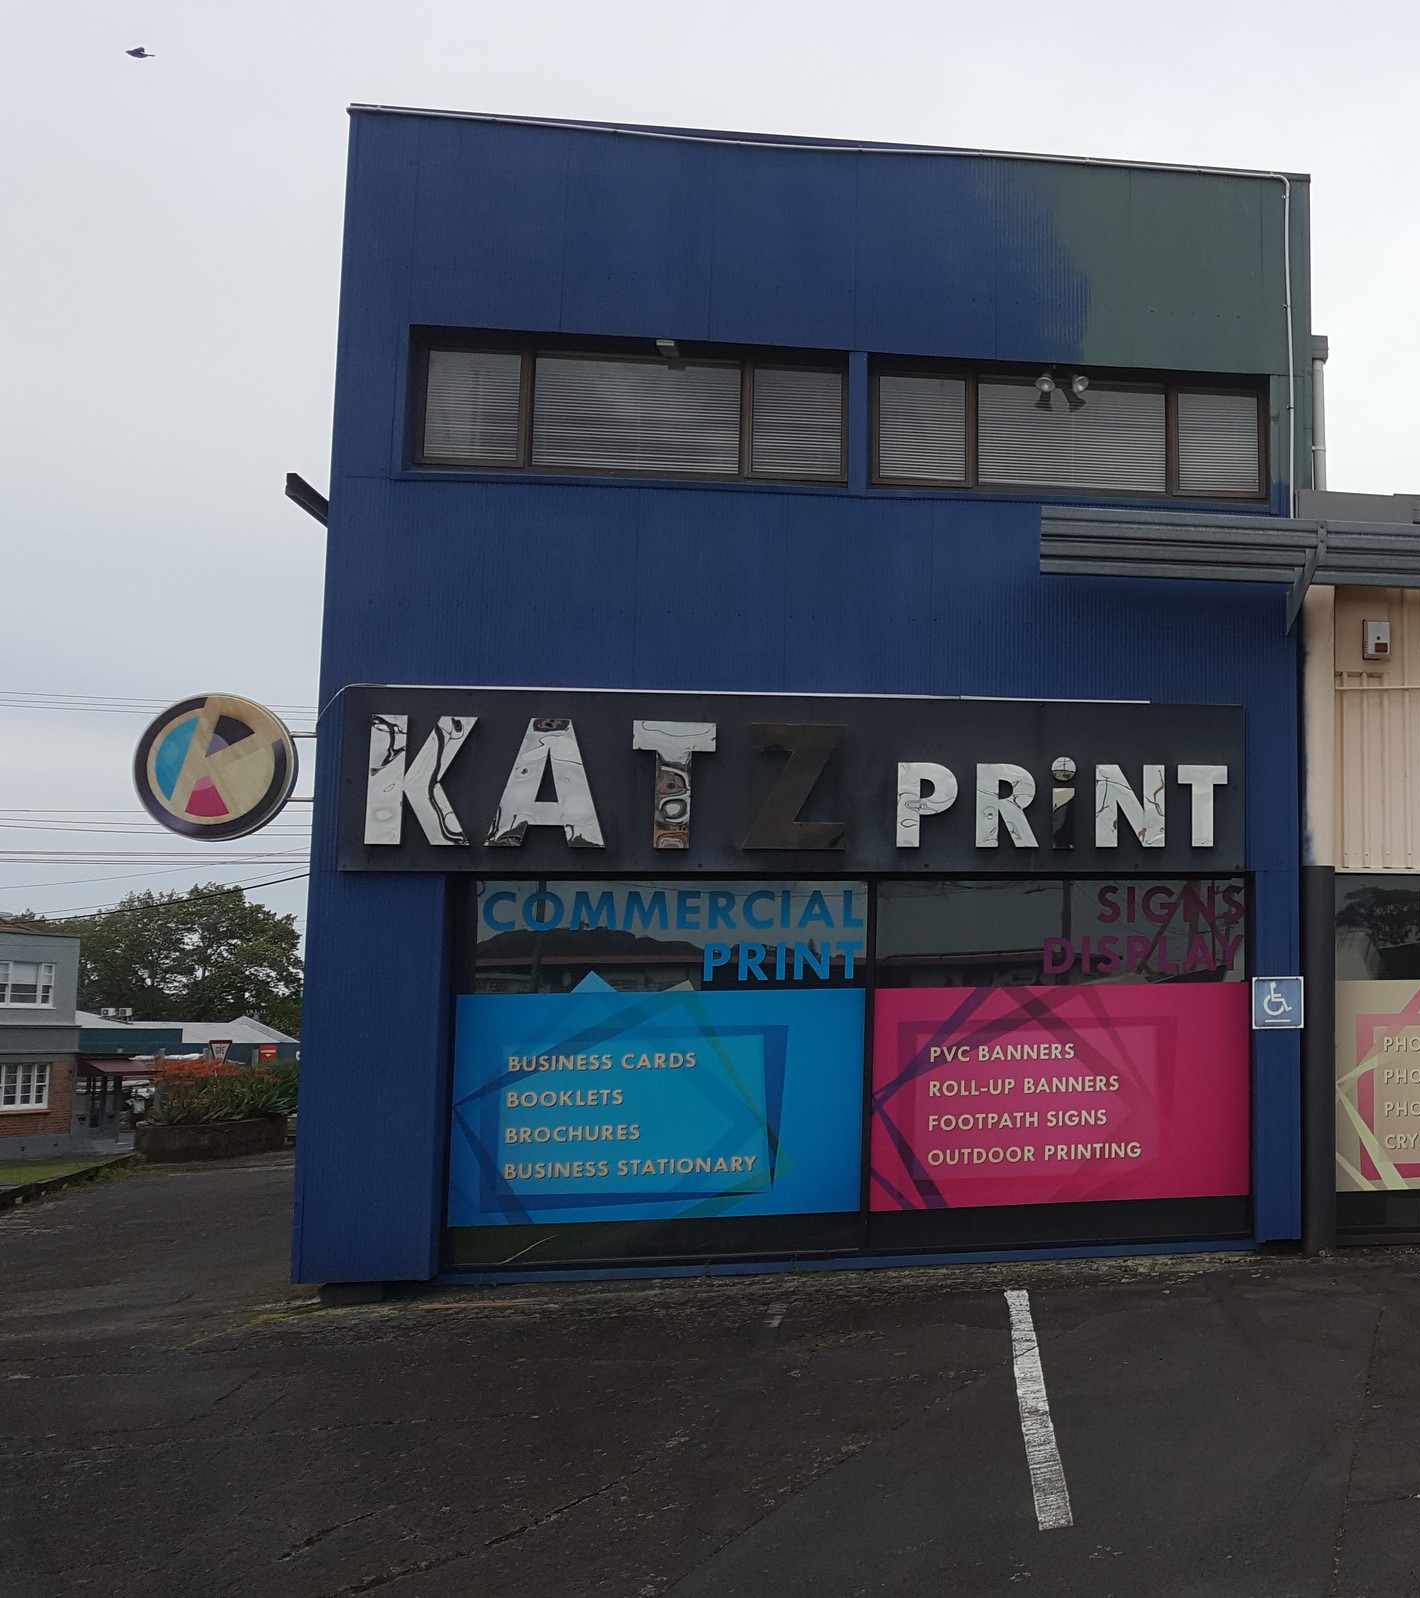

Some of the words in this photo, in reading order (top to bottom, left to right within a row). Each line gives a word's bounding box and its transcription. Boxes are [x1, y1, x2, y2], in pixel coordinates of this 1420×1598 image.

[363, 714, 848, 851] KATZ
[482, 889, 864, 932] COMMERCIAL
[1097, 885, 1245, 924] SIGNS
[703, 940, 864, 982] PRINT
[1043, 934, 1245, 975] DISPLAY
[508, 1054, 613, 1073] BUSINESS
[621, 1052, 697, 1070] CARDS
[930, 1046, 970, 1063] PVC
[978, 1043, 1076, 1062] BANNERS
[929, 1078, 1016, 1097] ROLL-UP
[1023, 1075, 1120, 1094] BANNERS
[506, 1089, 624, 1108] BOOKLETS
[928, 1112, 1039, 1131] FOOTPATH
[1046, 1109, 1108, 1127] SIGNS
[505, 1124, 641, 1144] BROCHURES
[927, 1146, 1036, 1166] OUTDOOR
[1044, 1142, 1142, 1161] PRINTING
[503, 1161, 610, 1180] BUSINESS
[617, 1155, 758, 1176] STATIONARY
